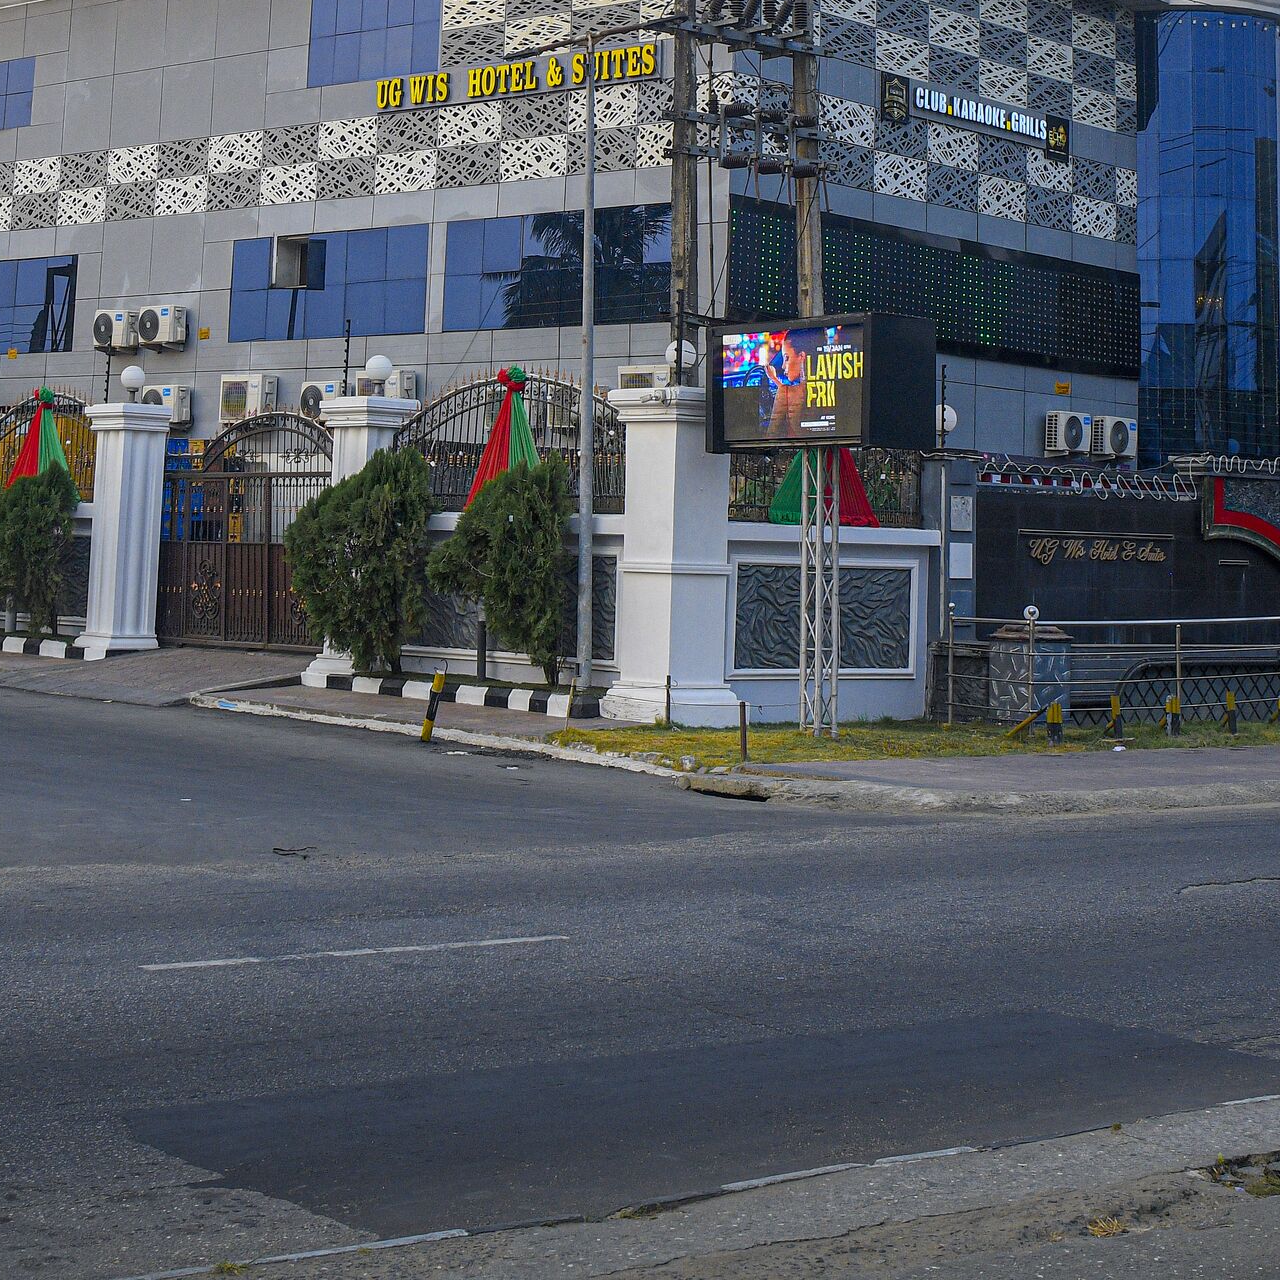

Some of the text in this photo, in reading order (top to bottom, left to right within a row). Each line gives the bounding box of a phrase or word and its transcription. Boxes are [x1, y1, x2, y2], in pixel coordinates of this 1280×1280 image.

[376, 79, 403, 107] UG
[410, 73, 449, 103] WIS
[467, 61, 536, 97] HOTEL
[546, 57, 562, 87] &
[806, 351, 863, 381] LAVISH
[1030, 538, 1059, 565] UG
[1090, 539, 1120, 560] Hotel
[1122, 540, 1136, 561] &
